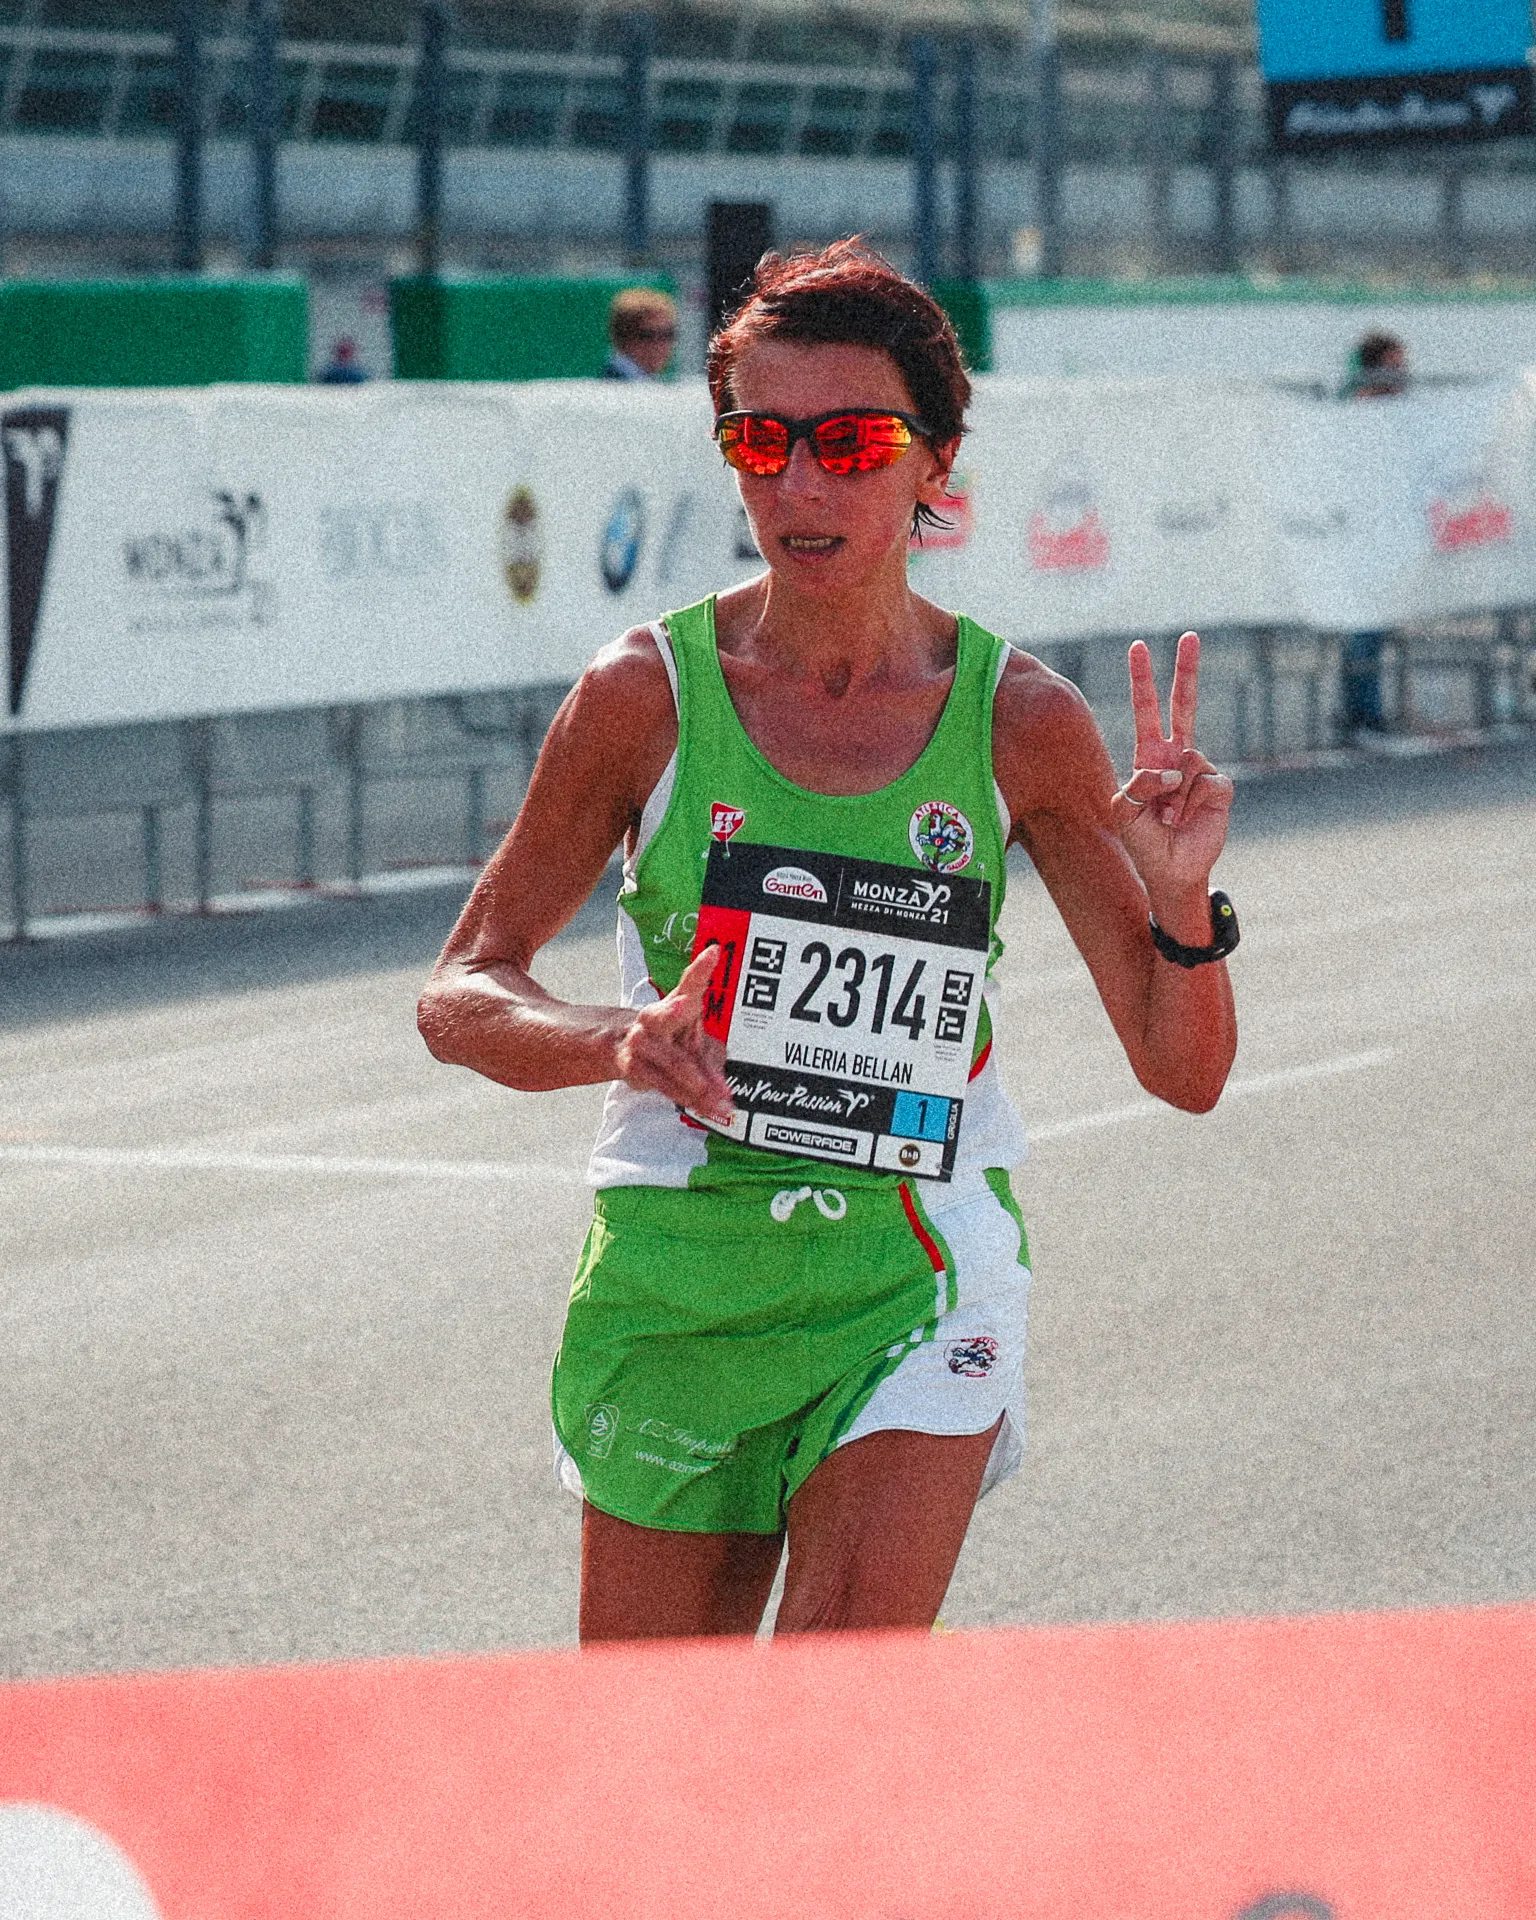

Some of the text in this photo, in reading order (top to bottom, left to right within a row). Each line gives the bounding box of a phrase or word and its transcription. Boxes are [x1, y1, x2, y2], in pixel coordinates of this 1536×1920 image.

[915, 802, 960, 821] ATLETICA
[853, 880, 921, 906] MONZA
[851, 901, 880, 913] MEZZA
[896, 910, 926, 921] MONZA
[930, 908, 949, 924] 21
[789, 941, 927, 1041] 2314
[785, 1042, 914, 1085] VALERIA BELLAN
[917, 1099, 929, 1135] 1
